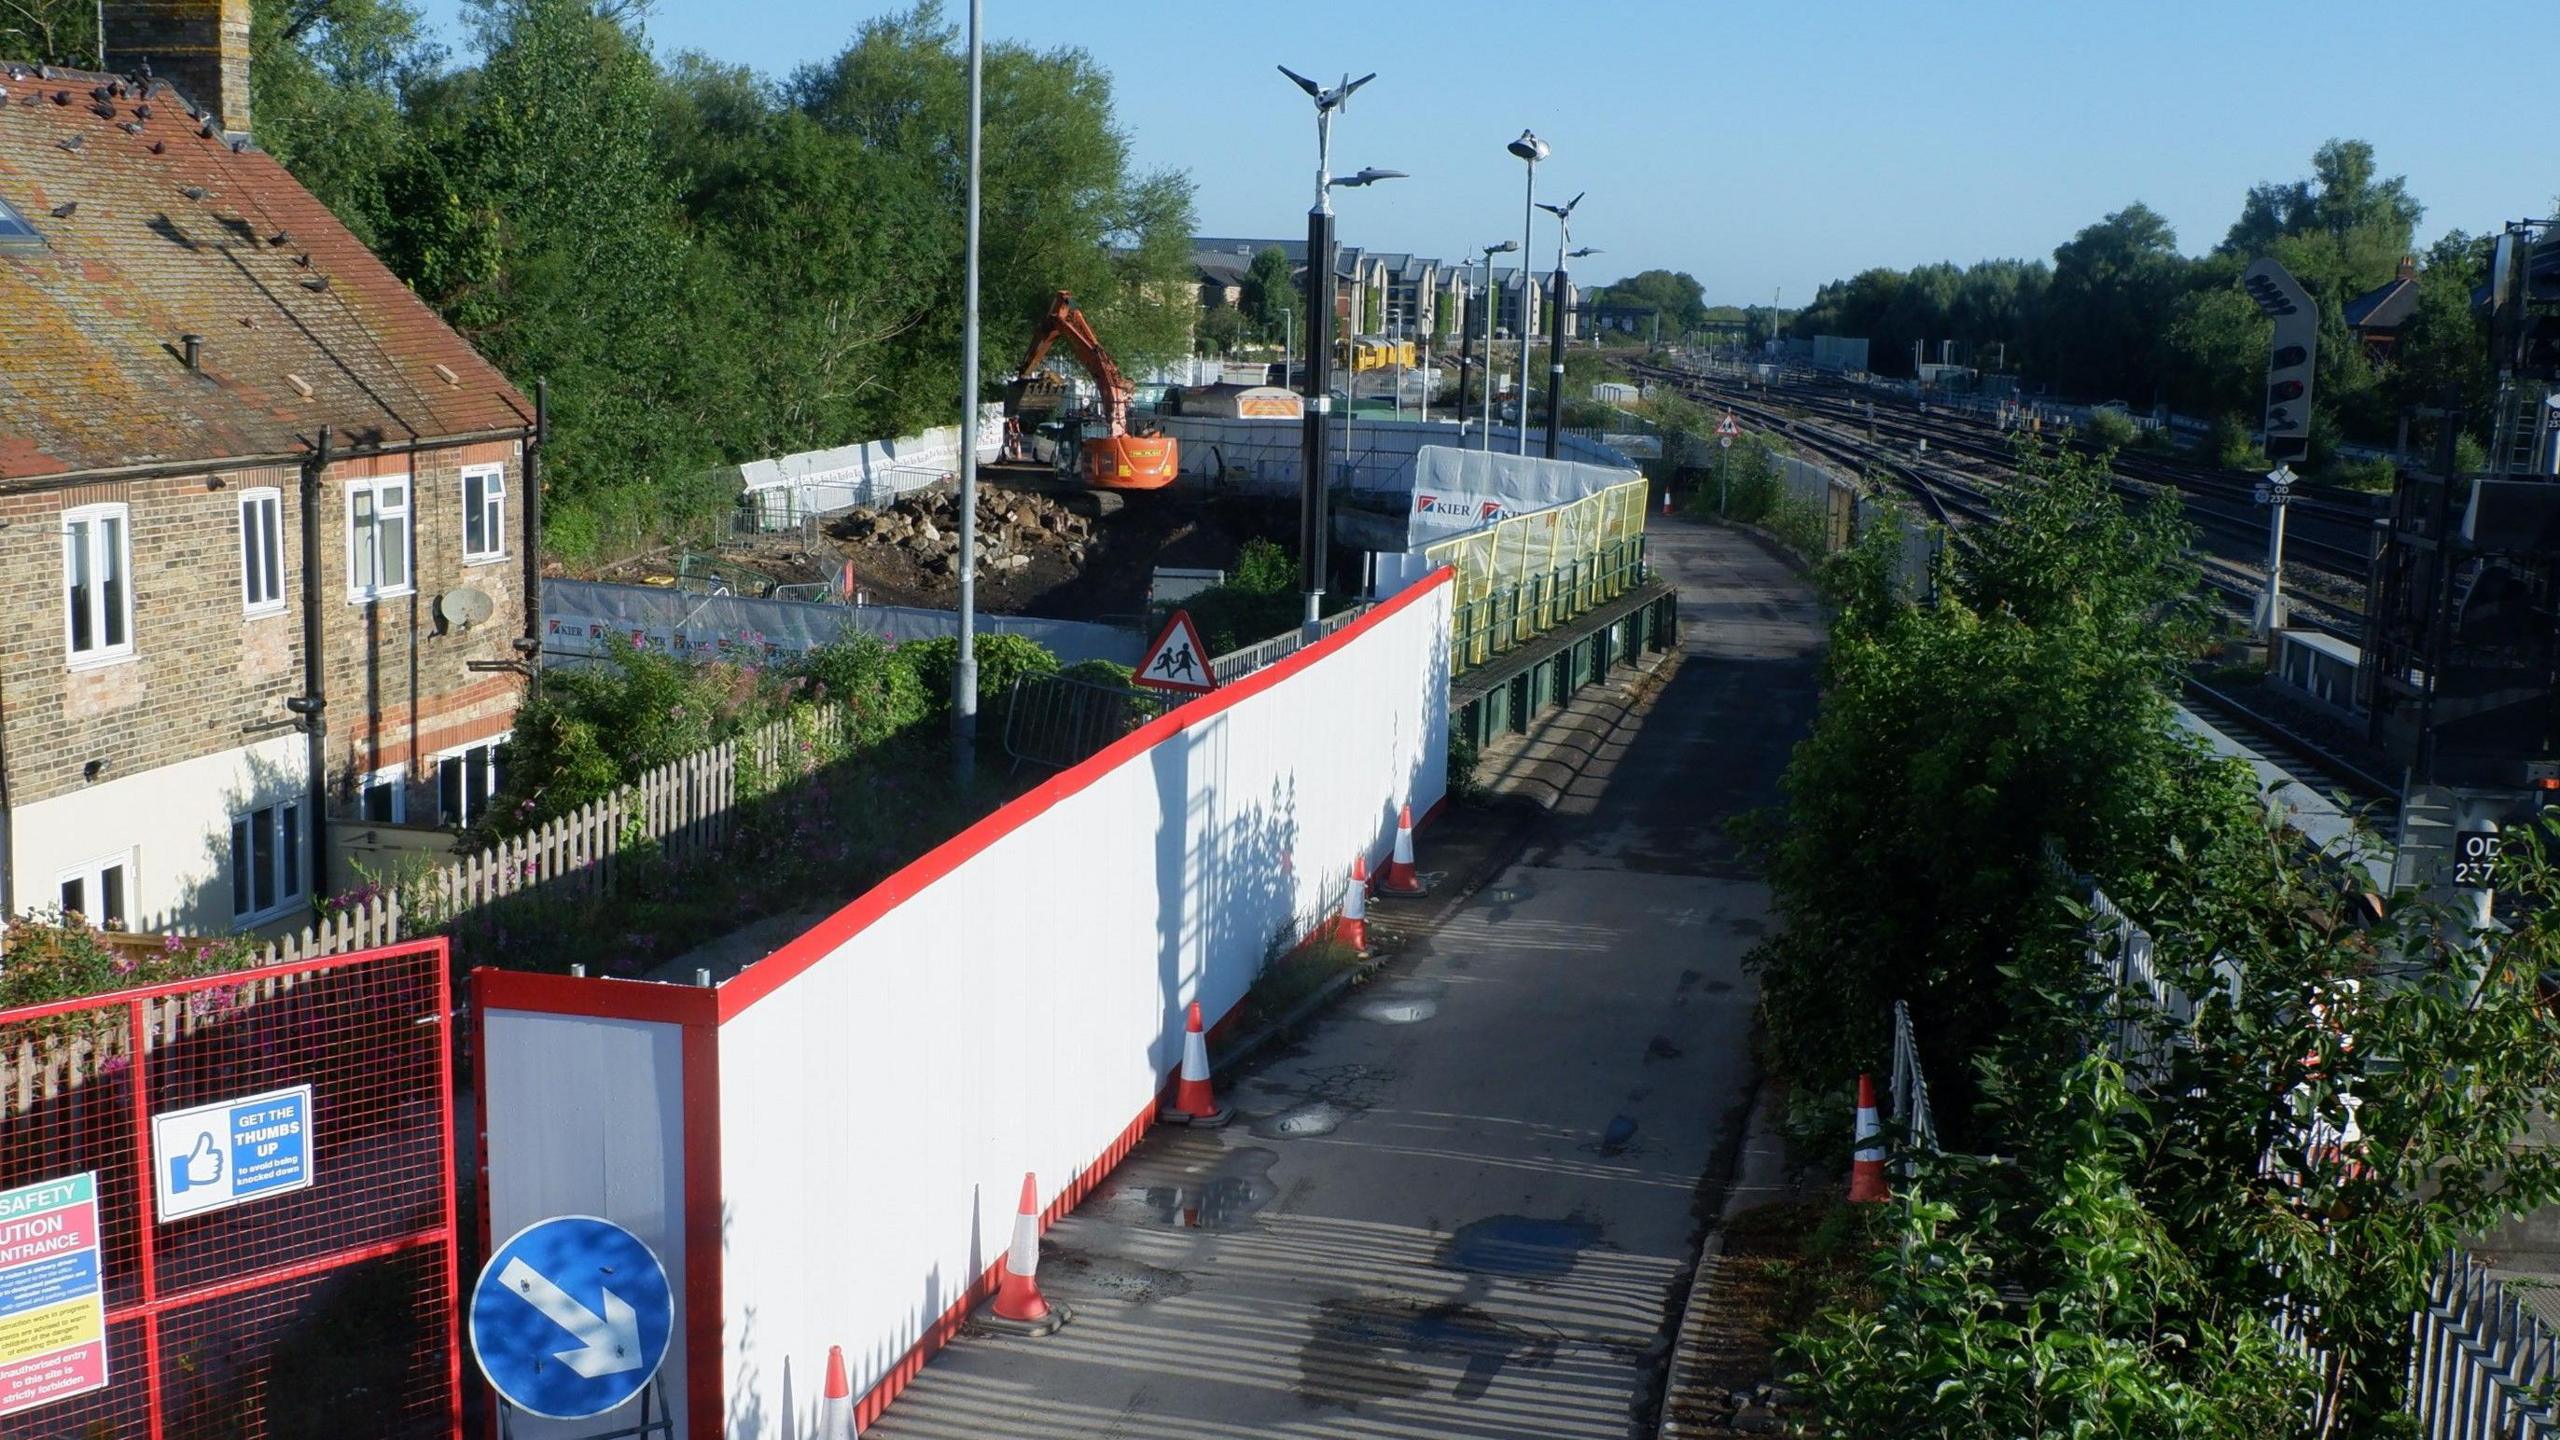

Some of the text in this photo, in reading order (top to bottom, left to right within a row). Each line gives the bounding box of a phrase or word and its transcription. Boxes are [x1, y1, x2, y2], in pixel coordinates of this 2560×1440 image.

[1437, 503, 1471, 517] KIER
[561, 624, 583, 637] KIER
[2466, 837, 2502, 857] OD
[239, 1105, 295, 1127] GET THE
[234, 1121, 300, 1146] THUMBS
[257, 1142, 279, 1157] UP
[237, 1165, 300, 1186] knocked down
[238, 1156, 299, 1175] to avoid being
[0, 1182, 76, 1216] SAFETY
[0, 1214, 63, 1245] UTION
[0, 1232, 80, 1262] NTRANCE
[33, 1313, 50, 1322] work
[2, 1338, 30, 1350] children
[62, 1350, 88, 1363] entry
[12, 1366, 74, 1389] to this site is
[3, 1375, 85, 1404] strictly forbidden
